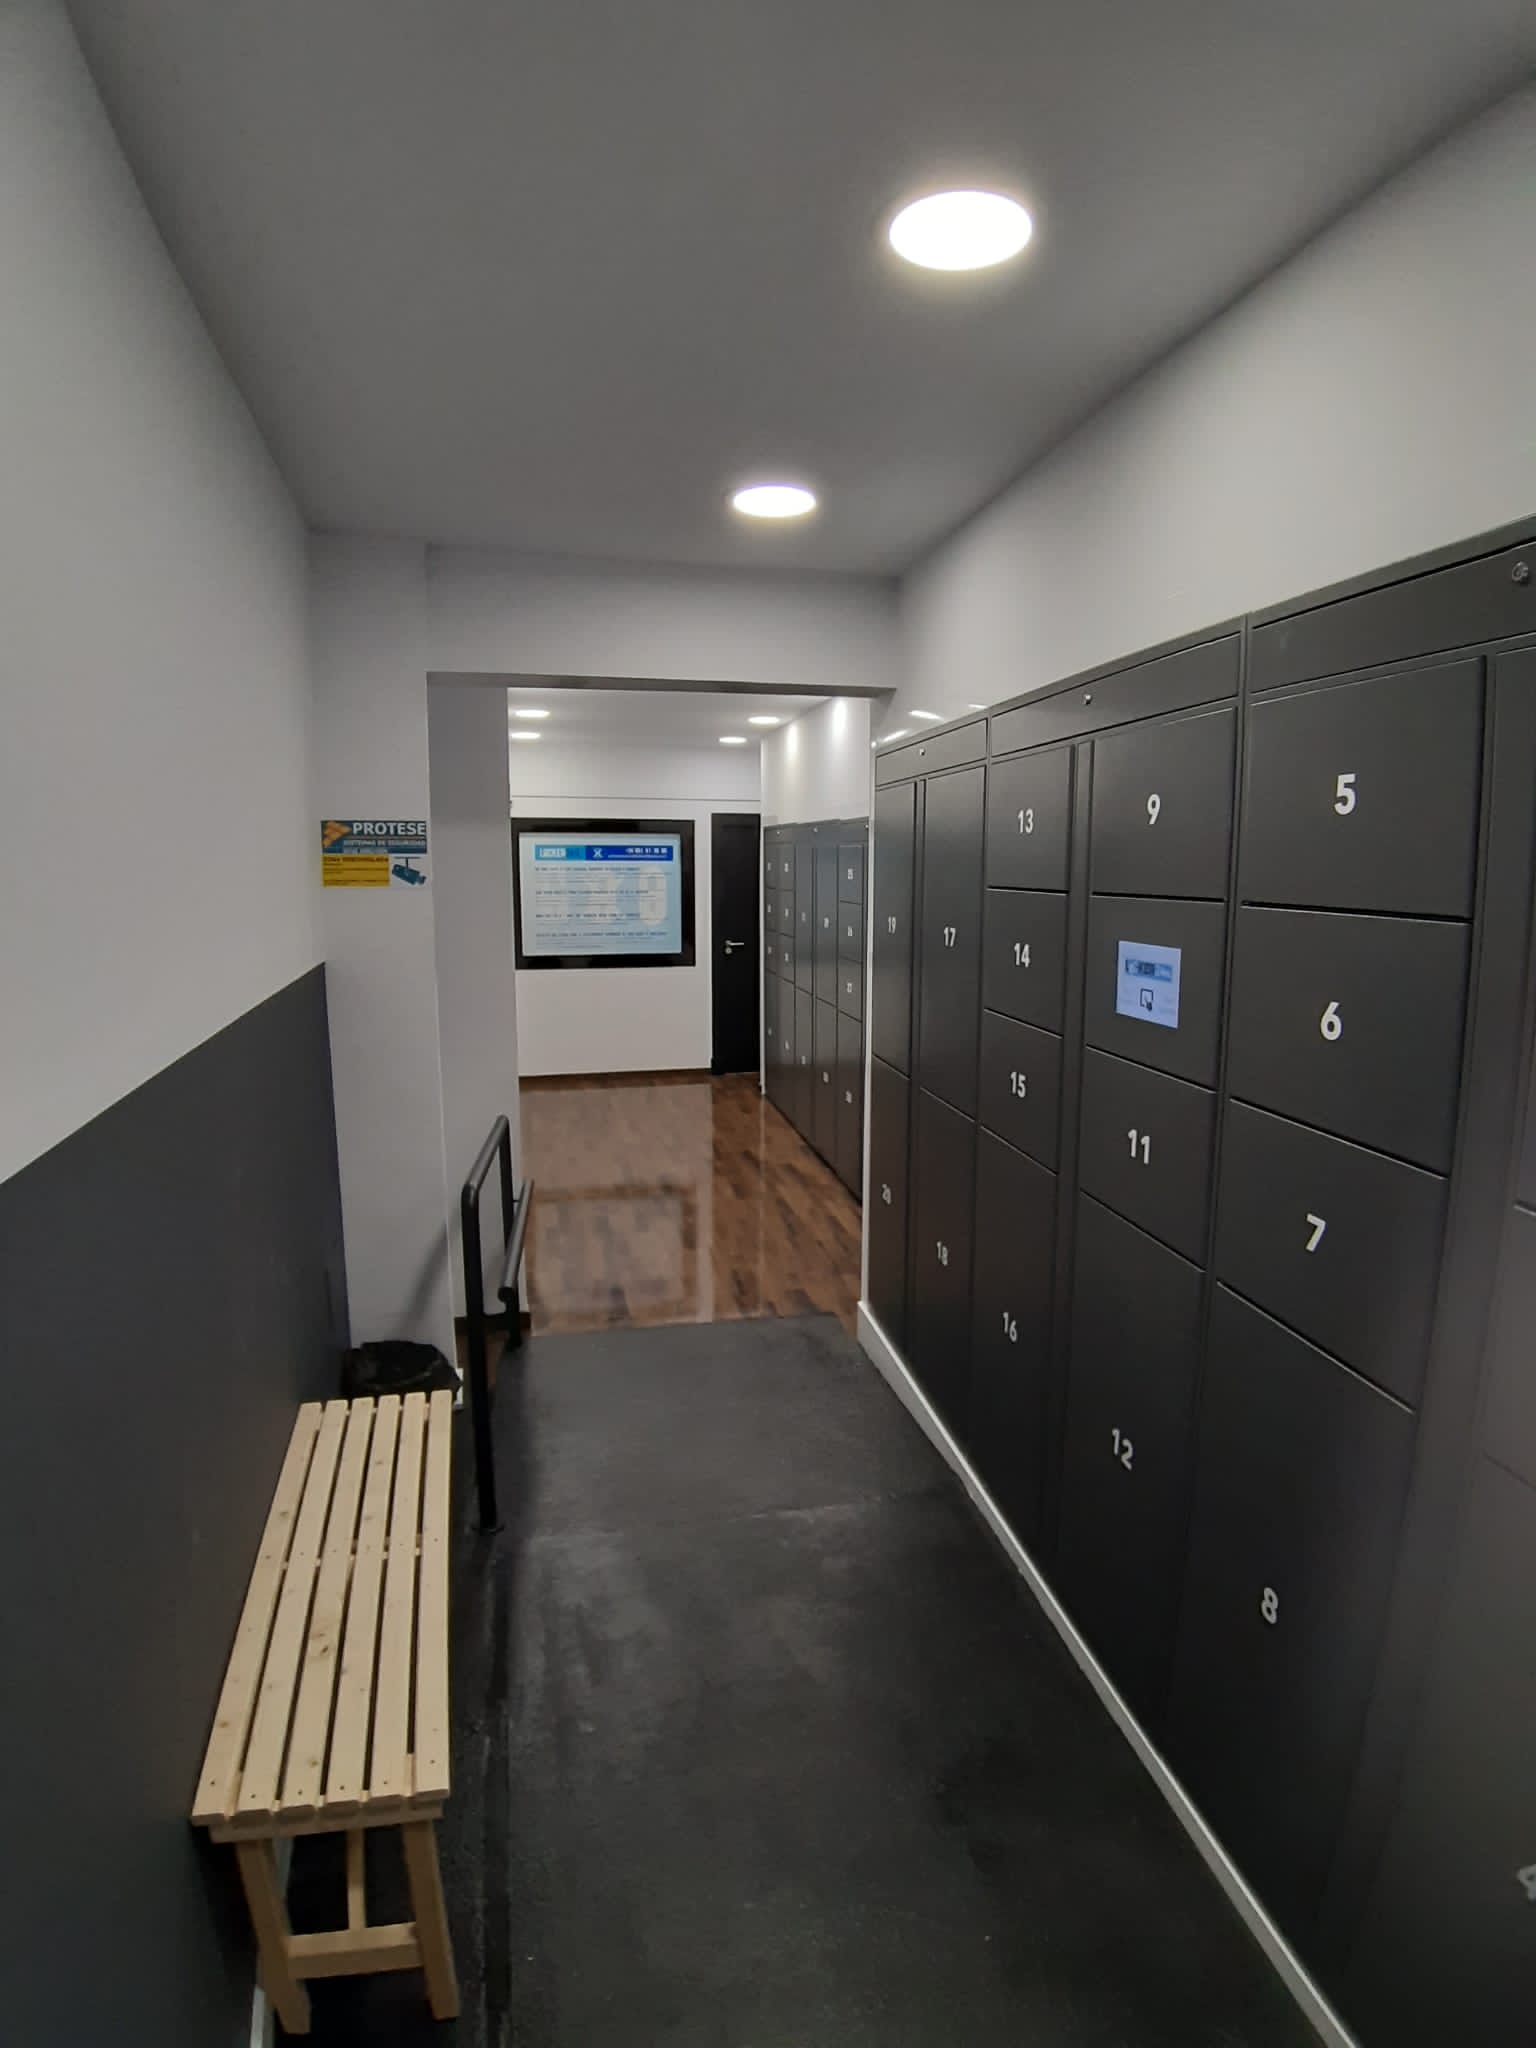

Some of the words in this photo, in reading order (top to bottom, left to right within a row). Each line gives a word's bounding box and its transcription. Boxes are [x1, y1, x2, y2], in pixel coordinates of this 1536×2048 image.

[1147, 793, 1161, 825] 9
[1334, 773, 1356, 815] 5
[352, 822, 426, 835] PROTESE
[1017, 808, 1034, 833] 13
[887, 916, 897, 933] 19
[943, 927, 956, 947] 17
[1014, 942, 1030, 968] 14
[1320, 1001, 1342, 1041] 6
[1010, 1071, 1026, 1098] 15
[1127, 1129, 1150, 1164] 11
[1306, 1213, 1326, 1252] 7
[1003, 1311, 1017, 1342] 16
[1111, 1428, 1133, 1470] 12
[1261, 1587, 1279, 1624] 8
